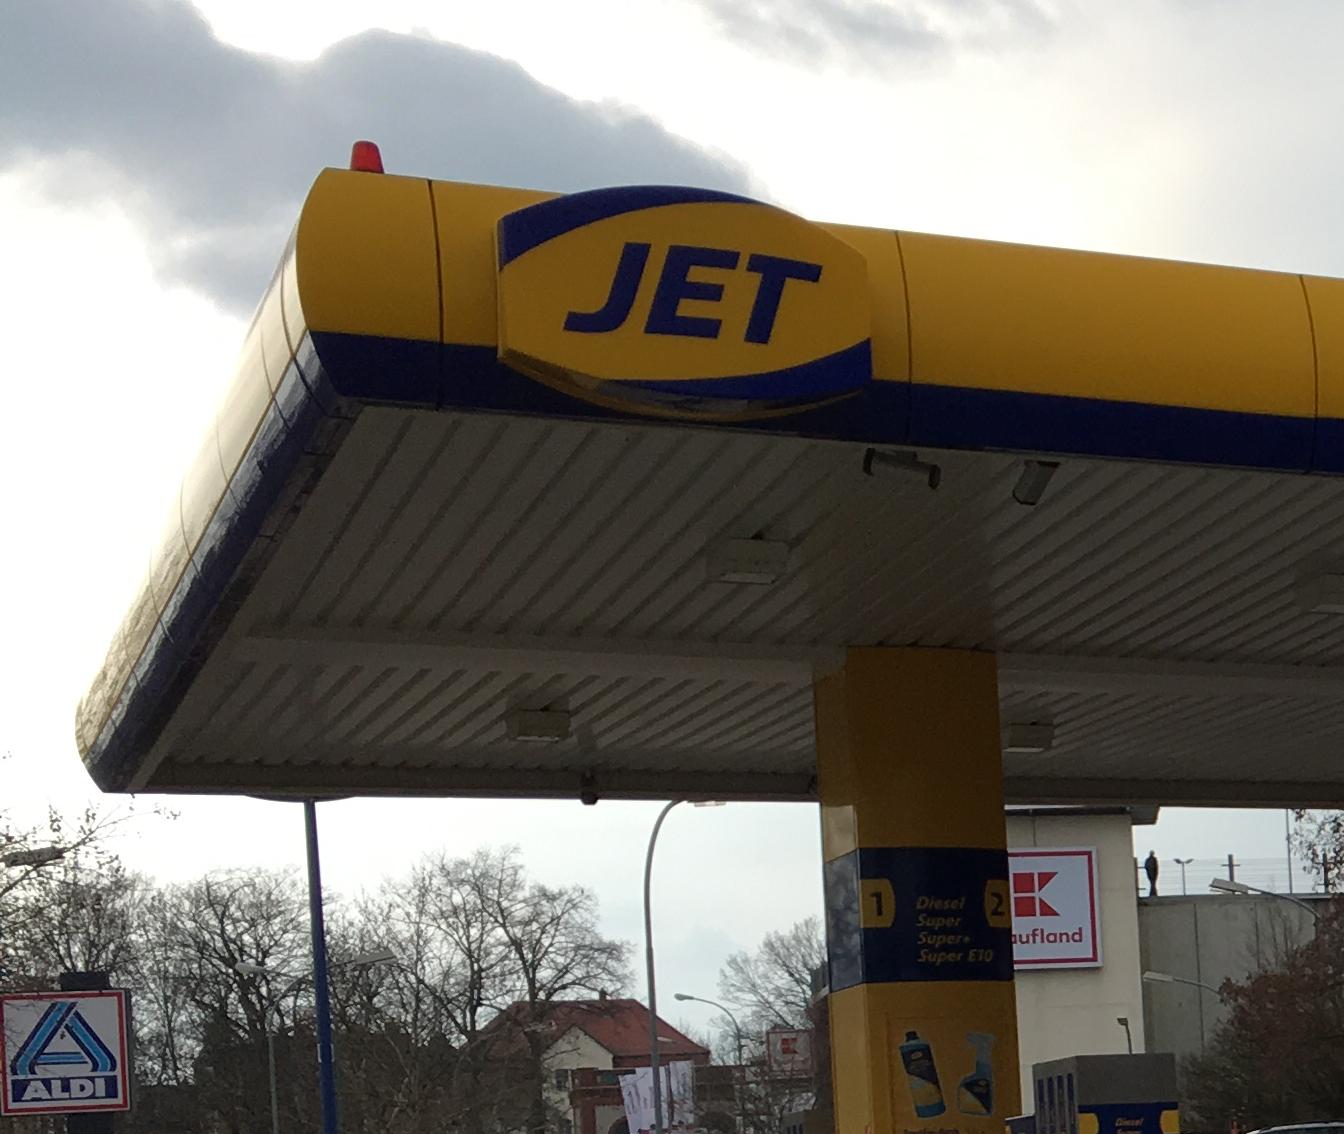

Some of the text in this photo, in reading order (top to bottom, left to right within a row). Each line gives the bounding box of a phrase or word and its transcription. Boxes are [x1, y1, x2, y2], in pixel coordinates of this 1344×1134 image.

[562, 241, 824, 344] JET
[870, 891, 883, 916] 1
[916, 896, 965, 910] Diesel
[991, 892, 1004, 916] 2
[916, 914, 962, 929] Super
[917, 931, 970, 946] Super+
[1011, 927, 1083, 944] aufland
[917, 949, 993, 965] Super E10
[21, 1077, 106, 1101] ALDI
